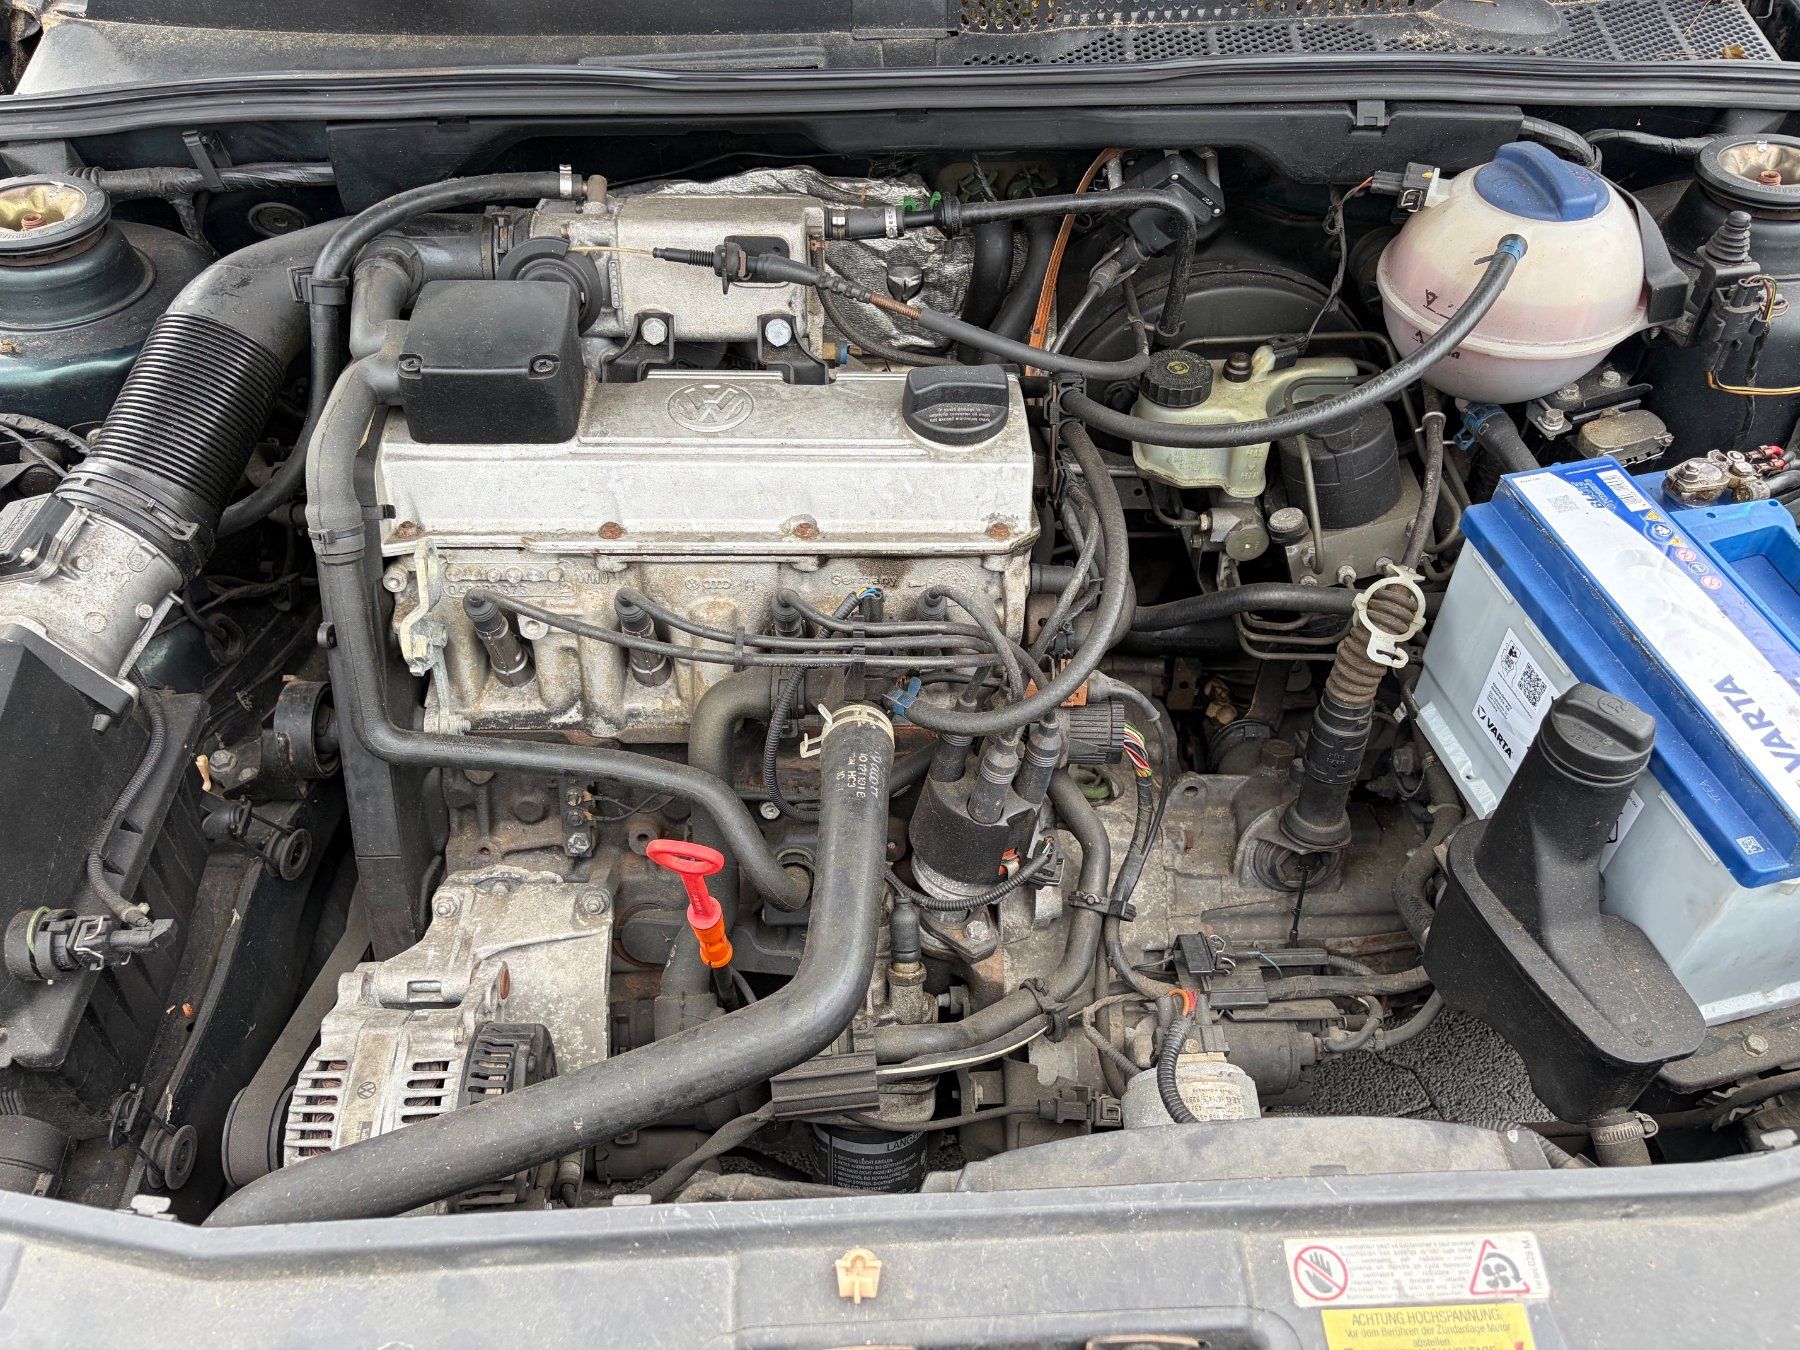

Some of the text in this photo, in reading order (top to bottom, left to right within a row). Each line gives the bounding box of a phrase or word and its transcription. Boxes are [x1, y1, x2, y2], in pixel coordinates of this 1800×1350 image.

[831, 574, 897, 588] Germany
[1714, 673, 1800, 774] VARTA
[1486, 717, 1512, 759] VARTA
[847, 770, 857, 788] HC3
[1352, 1307, 1501, 1326] ACHTUNG HOCHSPANNUNG
[1345, 1322, 1511, 1338] Vor dem Berühren der Zündanlage Motor
[1413, 1338, 1451, 1348] abstellen
